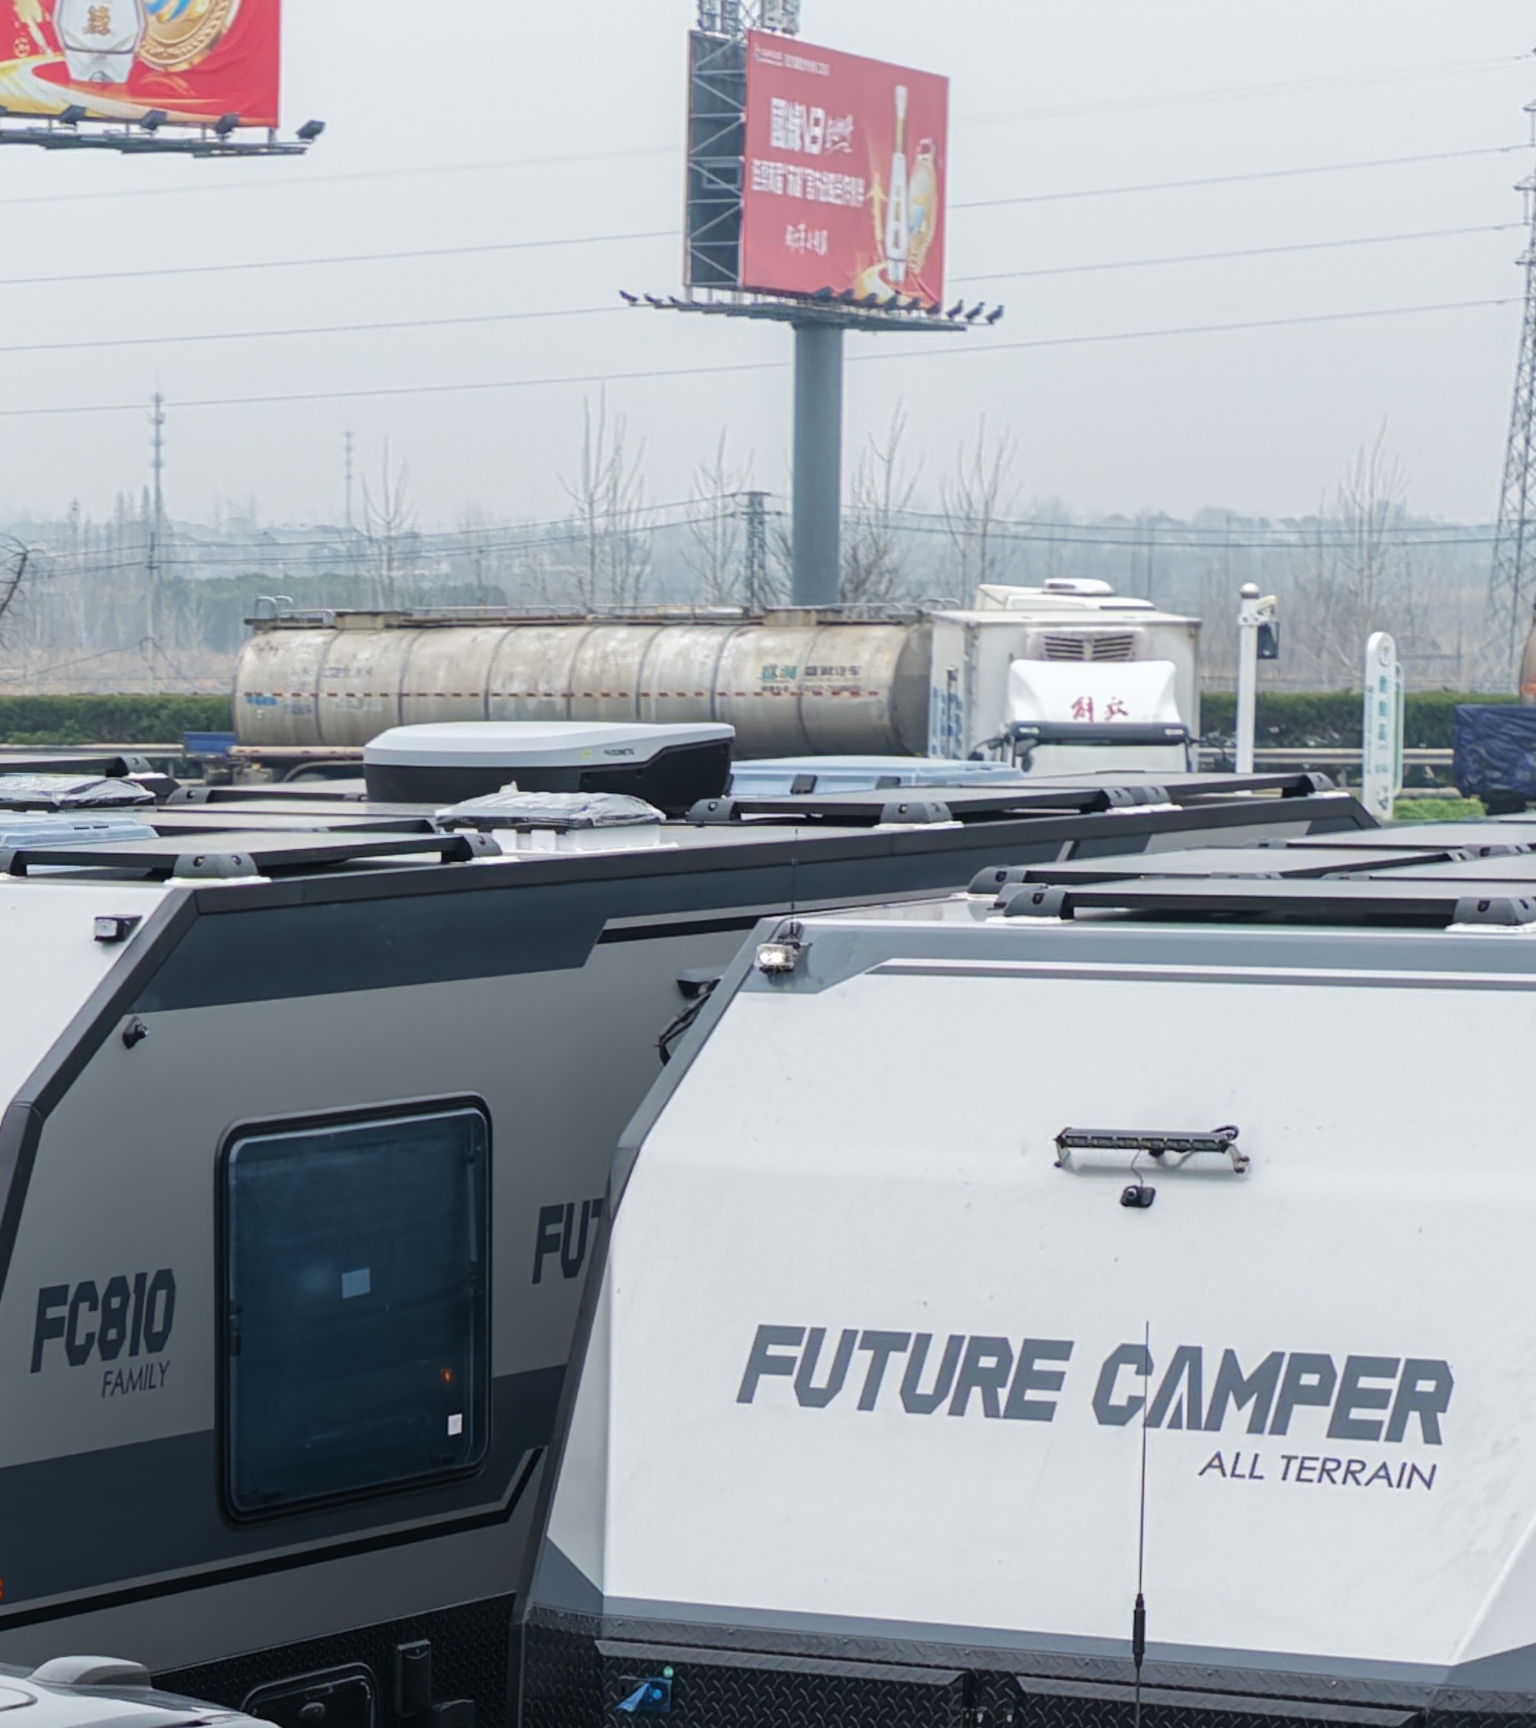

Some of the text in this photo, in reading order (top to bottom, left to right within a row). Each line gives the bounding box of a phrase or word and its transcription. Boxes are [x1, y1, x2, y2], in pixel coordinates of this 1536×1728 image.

[30, 1268, 176, 1374] FC810
[101, 1360, 171, 1399] FAMILY
[736, 1324, 1455, 1445] FUTURE CAMPER
[1199, 1451, 1438, 1491] ALL TERRAIN
